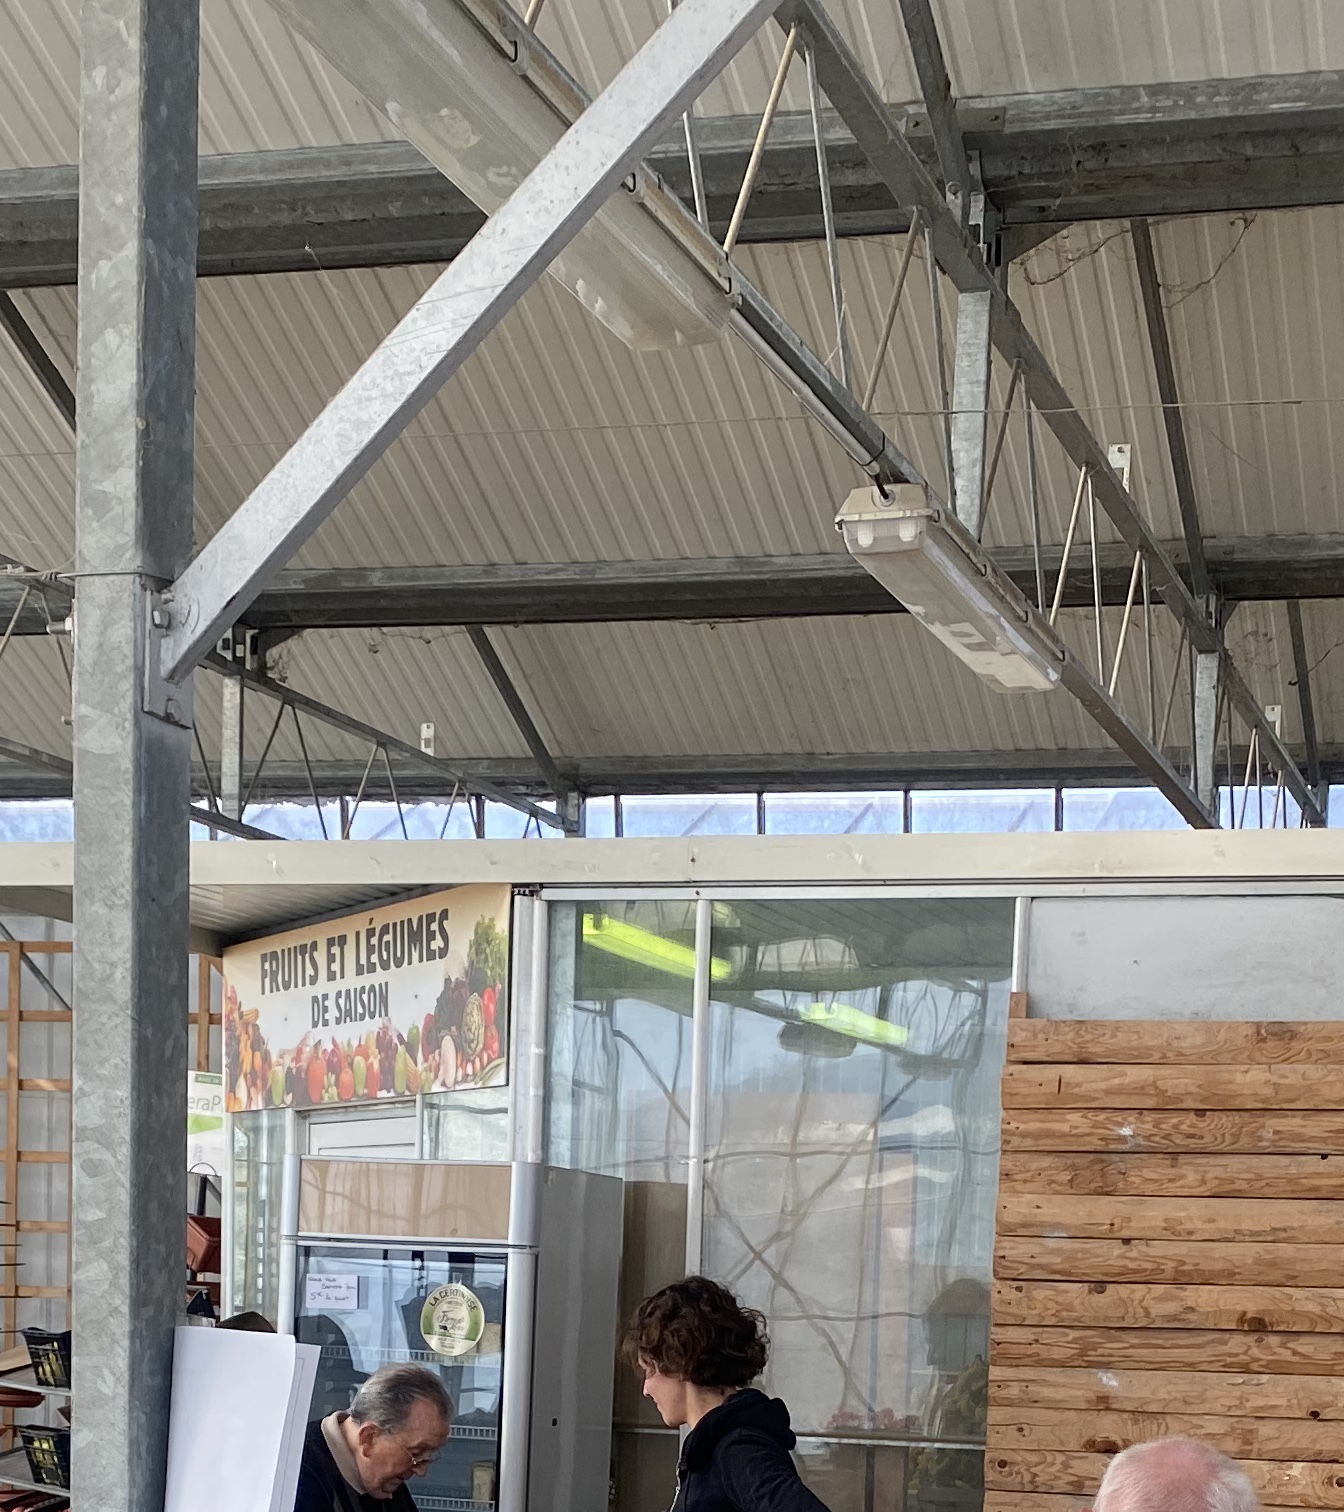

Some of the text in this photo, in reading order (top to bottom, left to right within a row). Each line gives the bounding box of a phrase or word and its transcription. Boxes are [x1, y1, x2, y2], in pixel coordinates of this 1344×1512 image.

[260, 908, 449, 995] FRUITS ET LÉGUMES
[311, 981, 389, 1029] DE SAISON
[429, 1297, 440, 1307] LA
